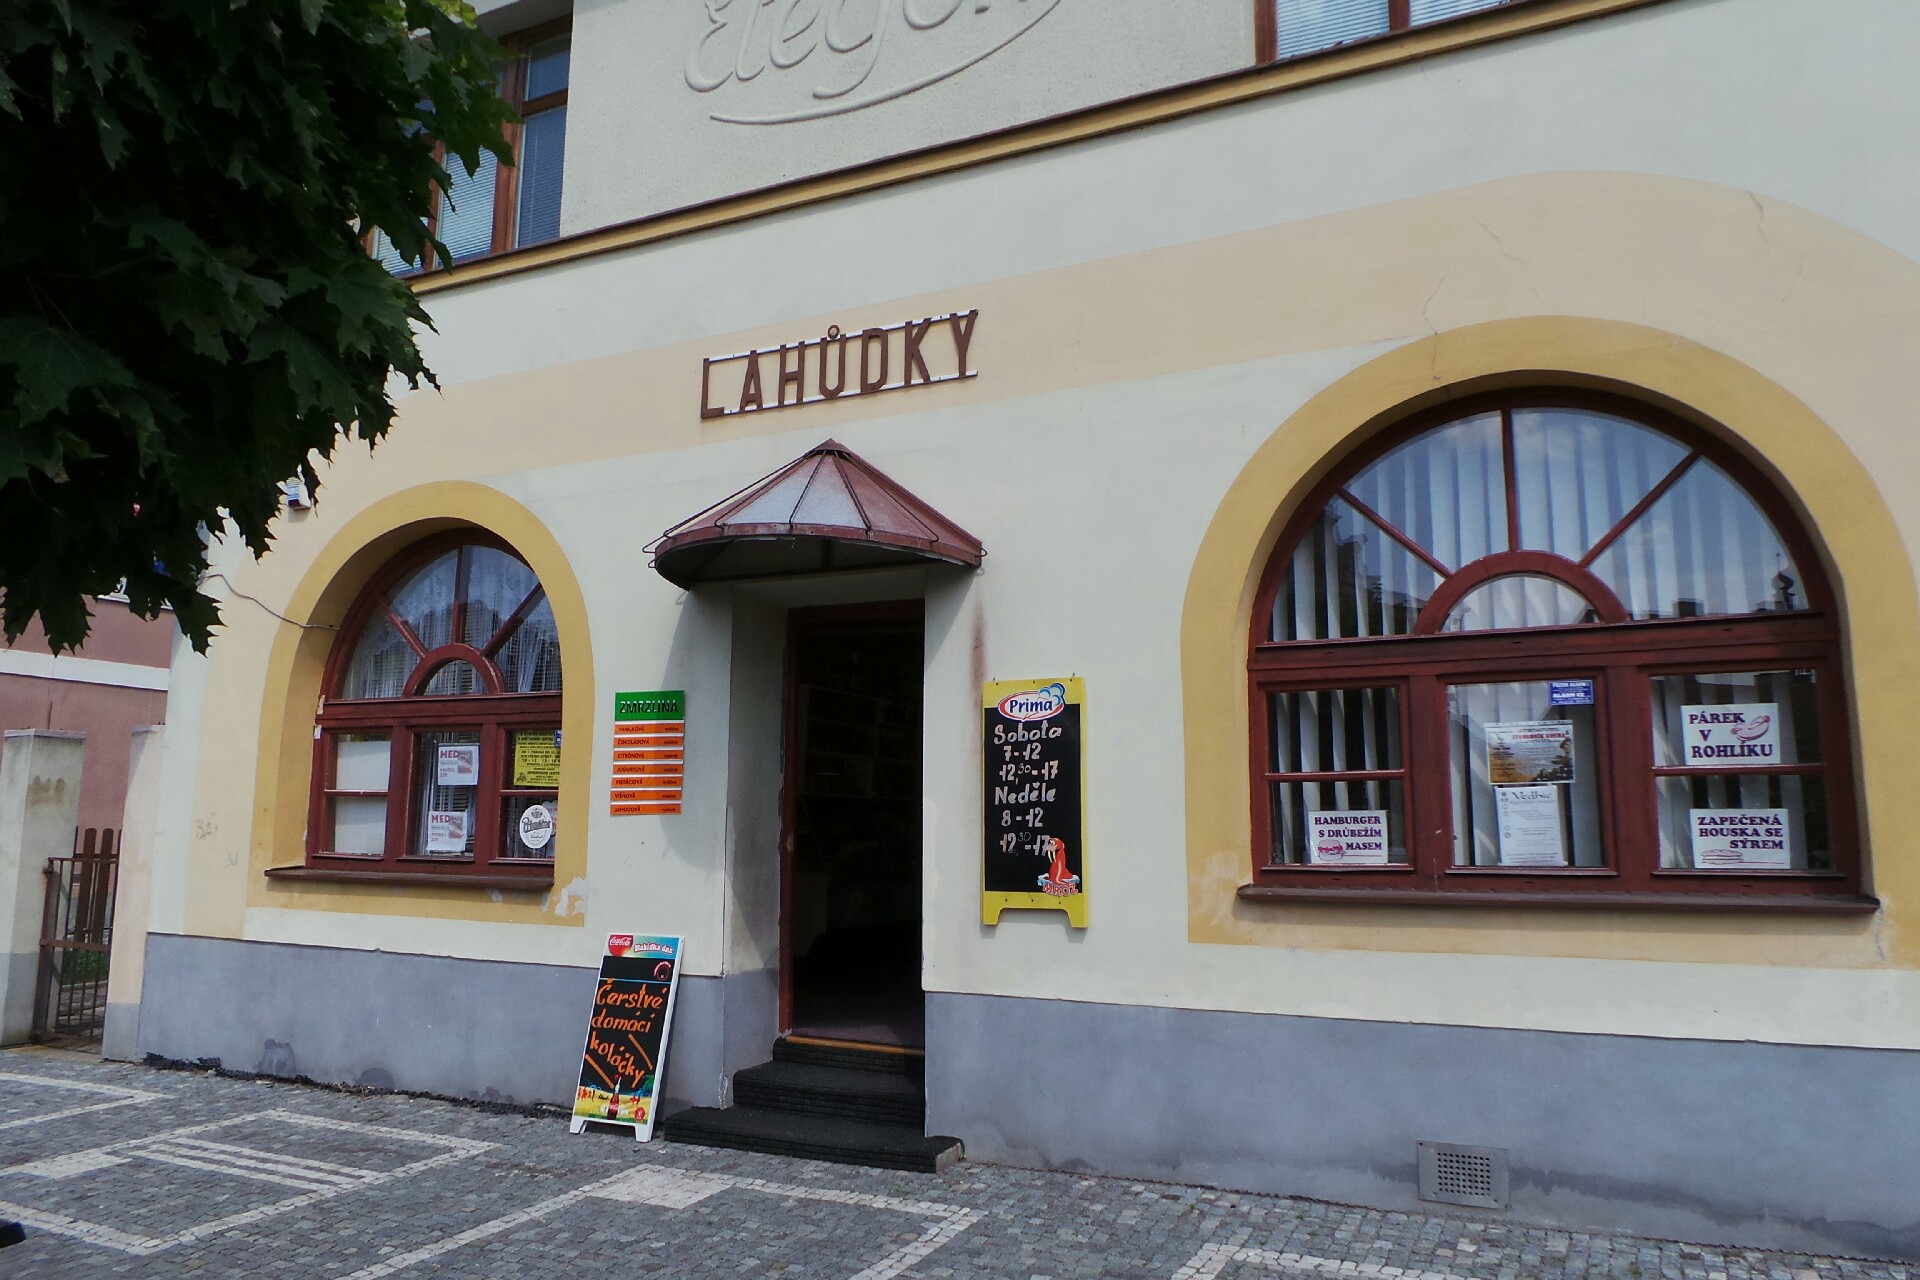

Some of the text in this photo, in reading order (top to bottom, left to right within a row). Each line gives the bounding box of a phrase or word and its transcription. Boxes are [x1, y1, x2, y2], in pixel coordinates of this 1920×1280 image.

[702, 309, 978, 418] LAHŮDKY
[619, 700, 678, 713] ZMRZLINA
[1009, 698, 1053, 713] Prima
[1689, 711, 1745, 724] PÁREK
[993, 719, 1062, 744] Sobota
[1699, 729, 1712, 741] V
[440, 750, 460, 758] MED
[1691, 741, 1773, 758] ROHLÍKU
[995, 781, 1056, 805] Neděle
[431, 814, 451, 823] MED
[1314, 816, 1381, 825] HAMBURGER
[1697, 814, 1783, 826] ZAPEČENÁ
[1327, 827, 1382, 837] DRŮBEŽÍM
[1699, 828, 1783, 837] HOUSKA SE
[1346, 842, 1382, 850] MASEM
[1730, 838, 1784, 849] SÝREM
[634, 942, 674, 954] Nabídka dne
[596, 978, 667, 1009] Čerstvé
[591, 1008, 656, 1033] domácí
[589, 1031, 645, 1089] koláčky
